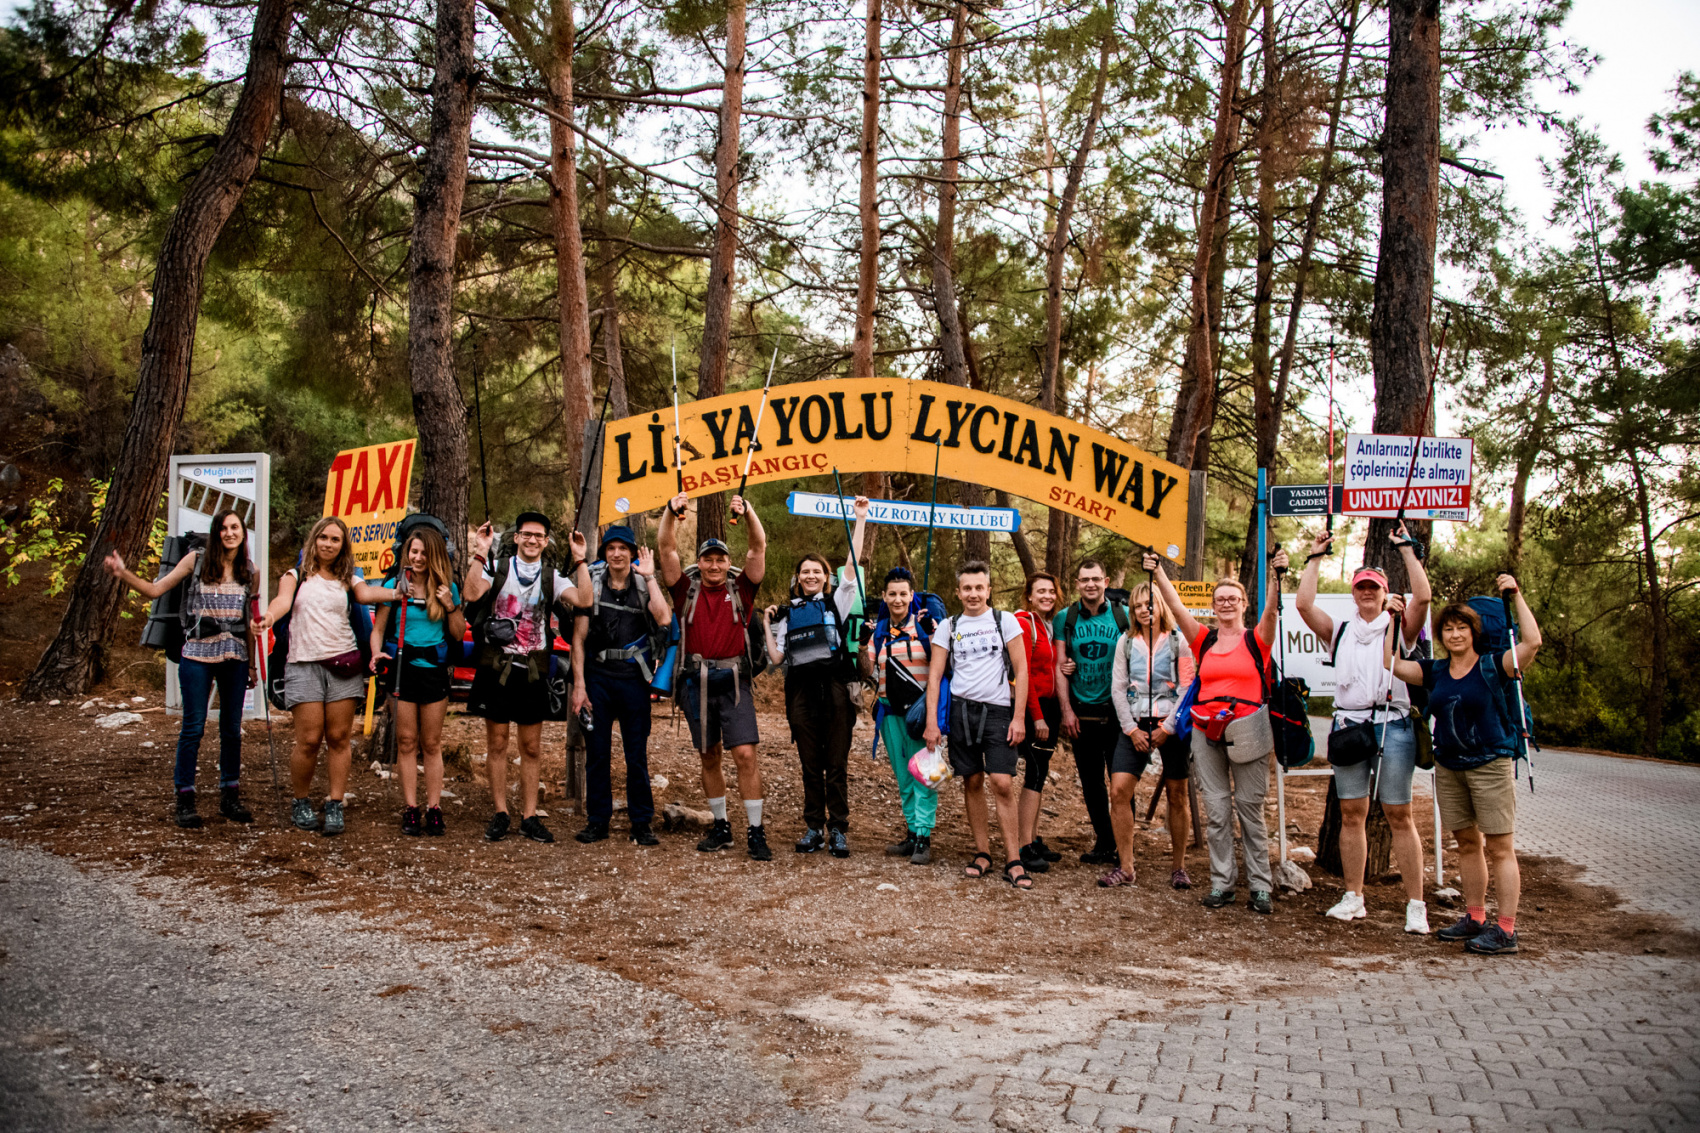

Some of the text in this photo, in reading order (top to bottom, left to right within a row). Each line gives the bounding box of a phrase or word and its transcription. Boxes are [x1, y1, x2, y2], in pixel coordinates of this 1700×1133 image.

[770, 391, 893, 447] YOLU
[910, 394, 1179, 520] LYCIAN WAY
[1422, 441, 1462, 460] birlikte
[203, 467, 254, 477] MuğlaKent
[331, 443, 413, 517] TAXI
[681, 453, 828, 493] BAŞLANGIÇ
[1350, 460, 1465, 485] çöplerinizi de almayı
[1289, 497, 1328, 506] CADDESİ
[1290, 489, 1327, 497] YASDAM
[1349, 488, 1463, 509] UNUTMAYINIZ!
[1049, 486, 1117, 522] START
[891, 508, 947, 524] ROTARY
[949, 512, 1010, 527] KULÜBÜ
[1179, 582, 1203, 592] Green
[1205, 583, 1215, 592] Pa
[1087, 644, 1101, 658] 27
[1287, 631, 1328, 653] MON
